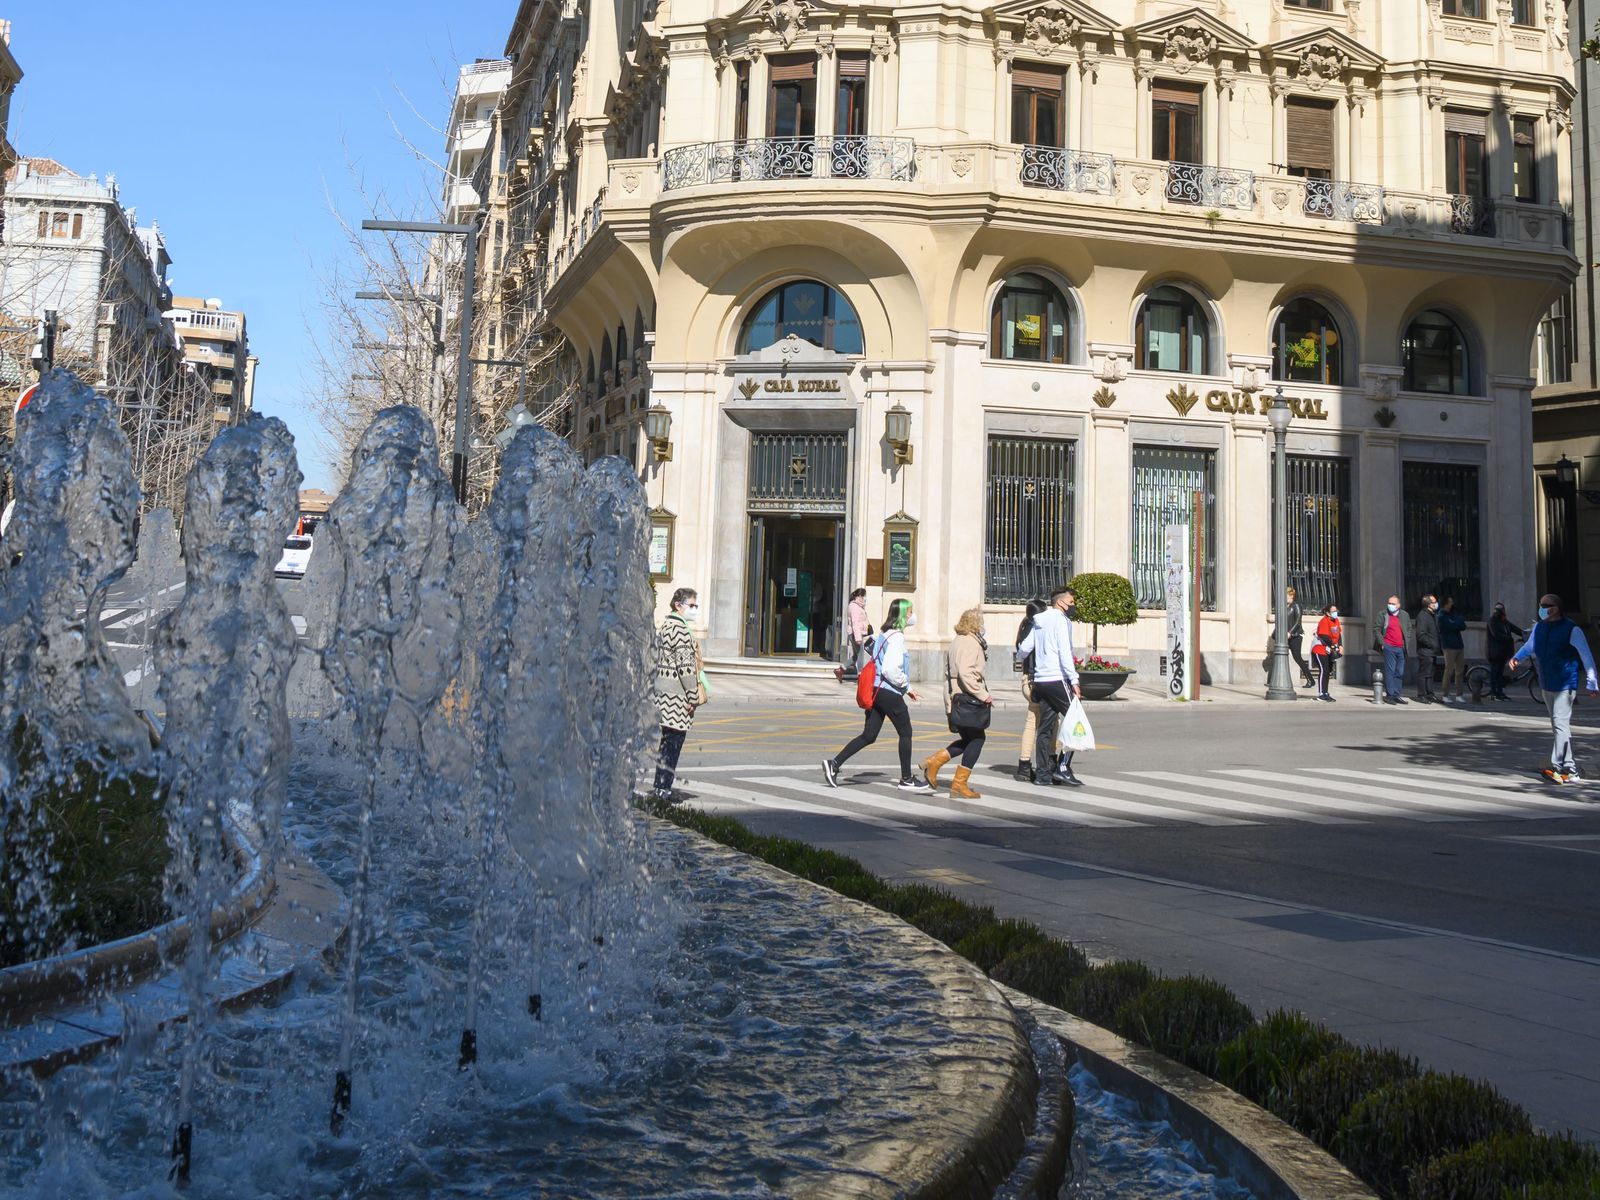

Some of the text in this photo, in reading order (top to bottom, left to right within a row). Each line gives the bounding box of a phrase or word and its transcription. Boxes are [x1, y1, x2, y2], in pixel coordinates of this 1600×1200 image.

[764, 379, 840, 393] CAJA RURAL
[1205, 390, 1328, 420] CAJA RRAL
